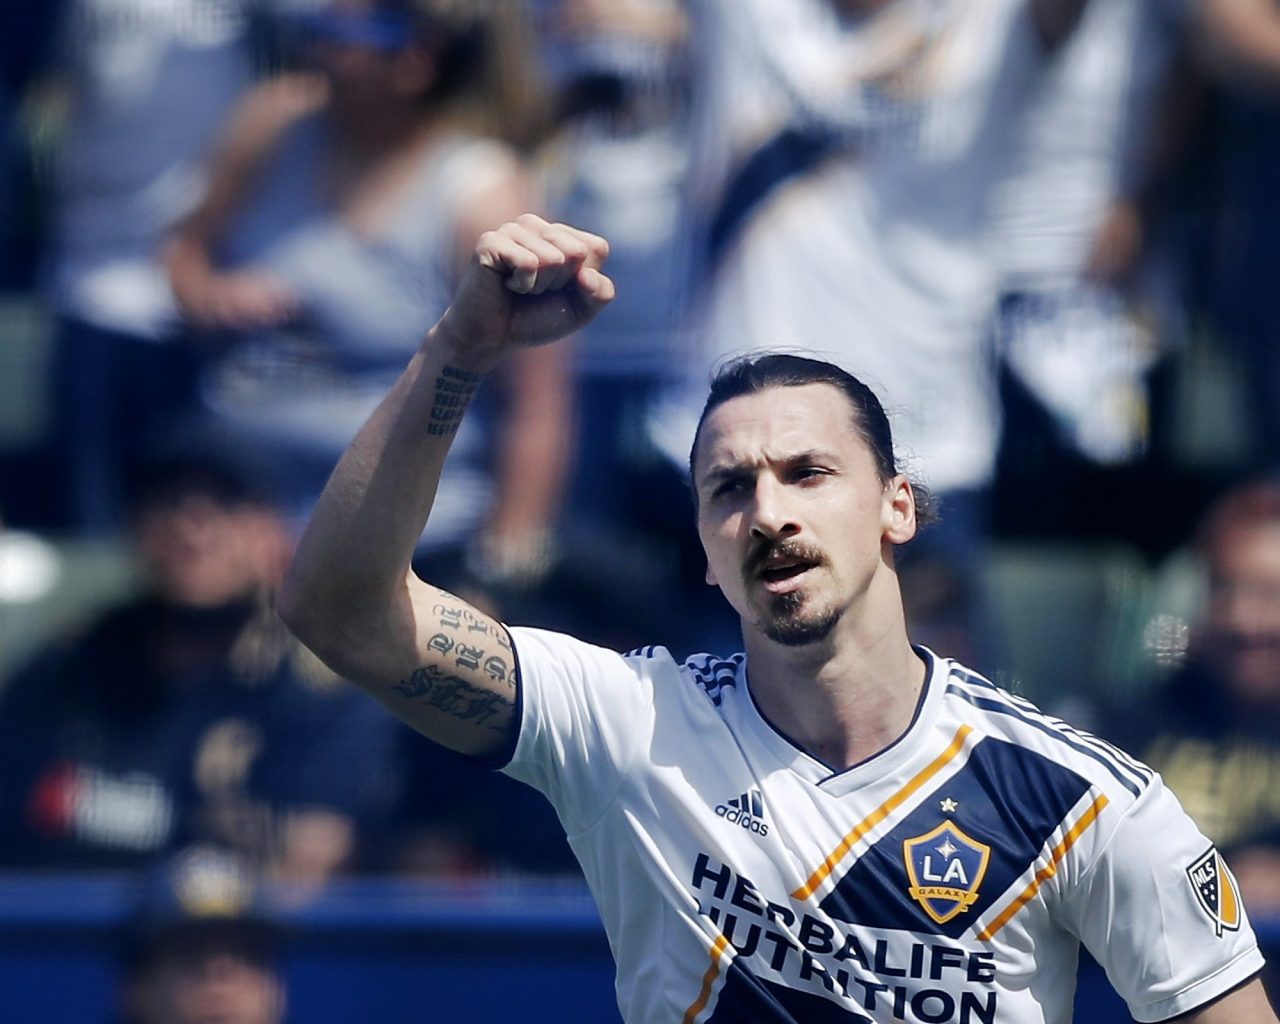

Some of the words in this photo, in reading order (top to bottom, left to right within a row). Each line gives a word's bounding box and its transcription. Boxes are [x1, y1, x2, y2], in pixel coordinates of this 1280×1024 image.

[714, 804, 769, 837] adidas
[923, 855, 968, 884] LA
[1193, 861, 1215, 888] MLS
[918, 888, 969, 899] GALAXY
